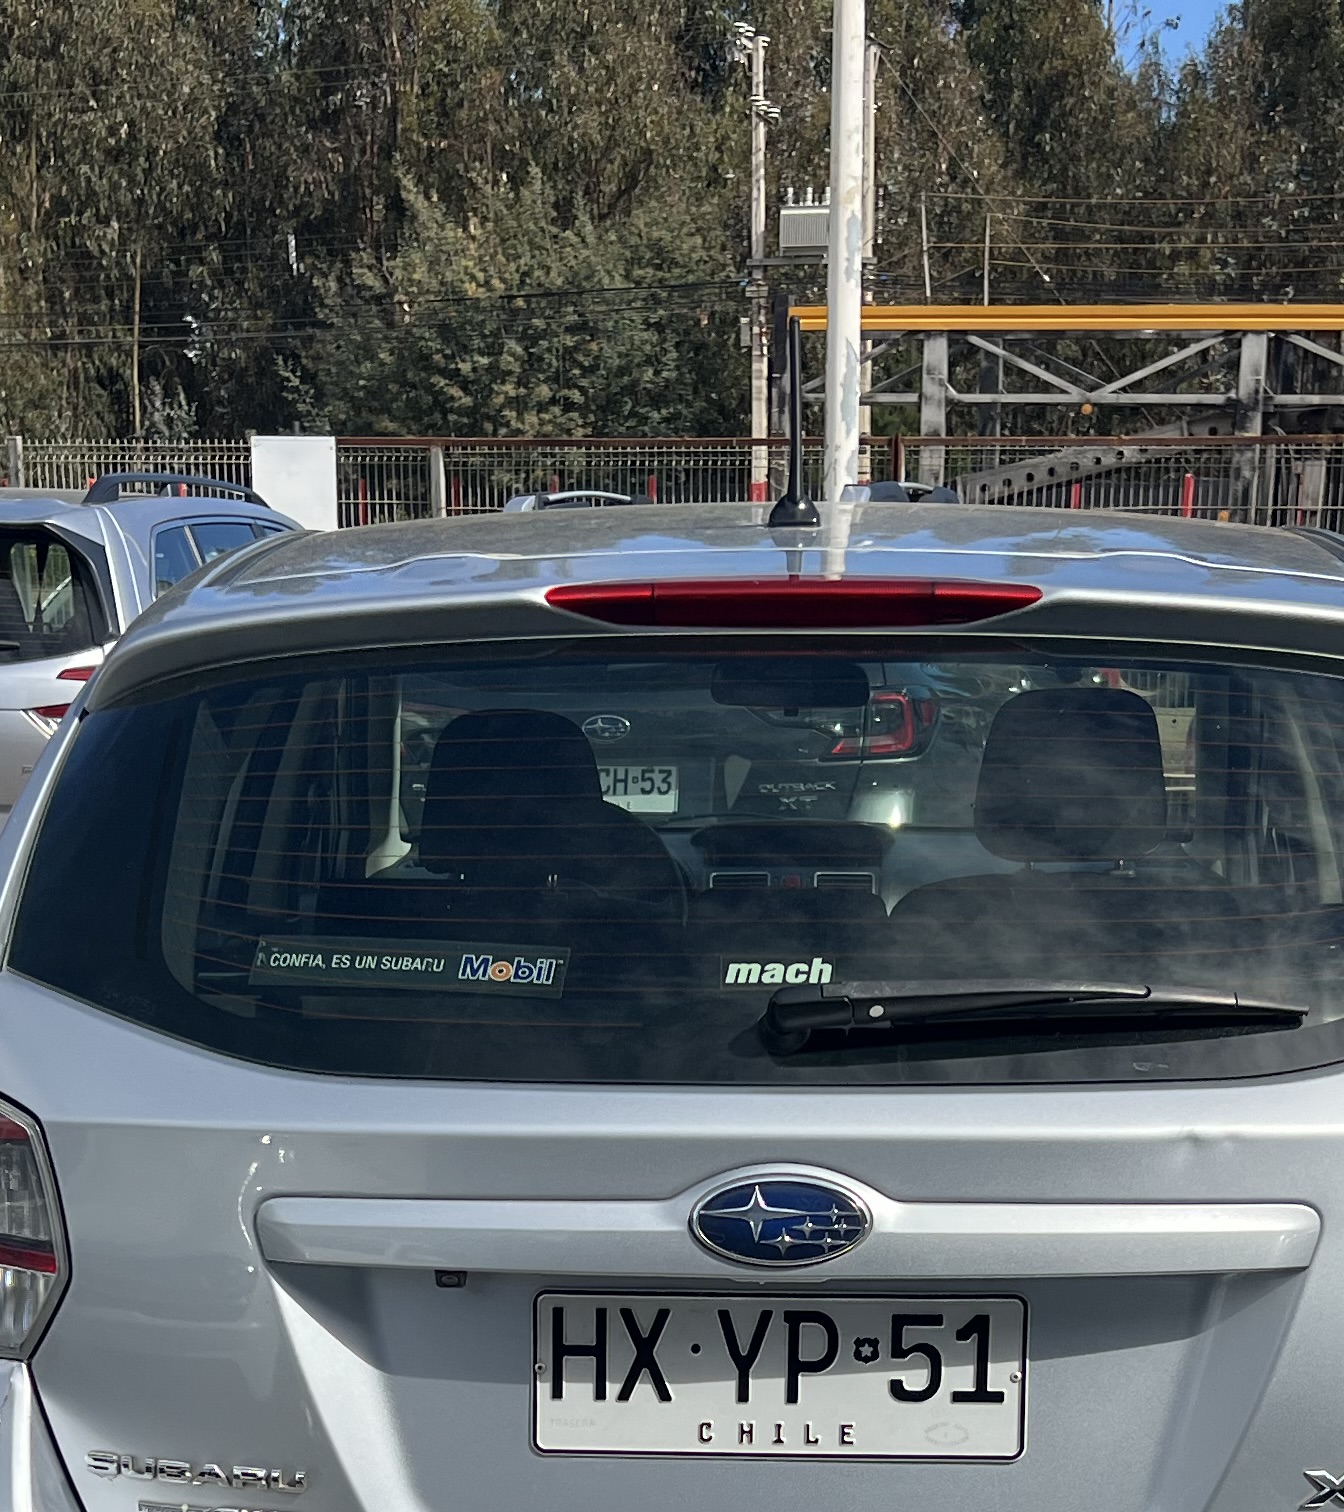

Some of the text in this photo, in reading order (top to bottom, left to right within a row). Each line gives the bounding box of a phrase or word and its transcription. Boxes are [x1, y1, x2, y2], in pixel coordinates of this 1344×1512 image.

[758, 782, 836, 793] OUTBACK
[270, 953, 557, 985] CONFIA, ES UN SUBARU Mobil
[724, 957, 833, 984] mach
[699, 1422, 857, 1446] CHILE
[84, 1450, 307, 1495] SUBARU
